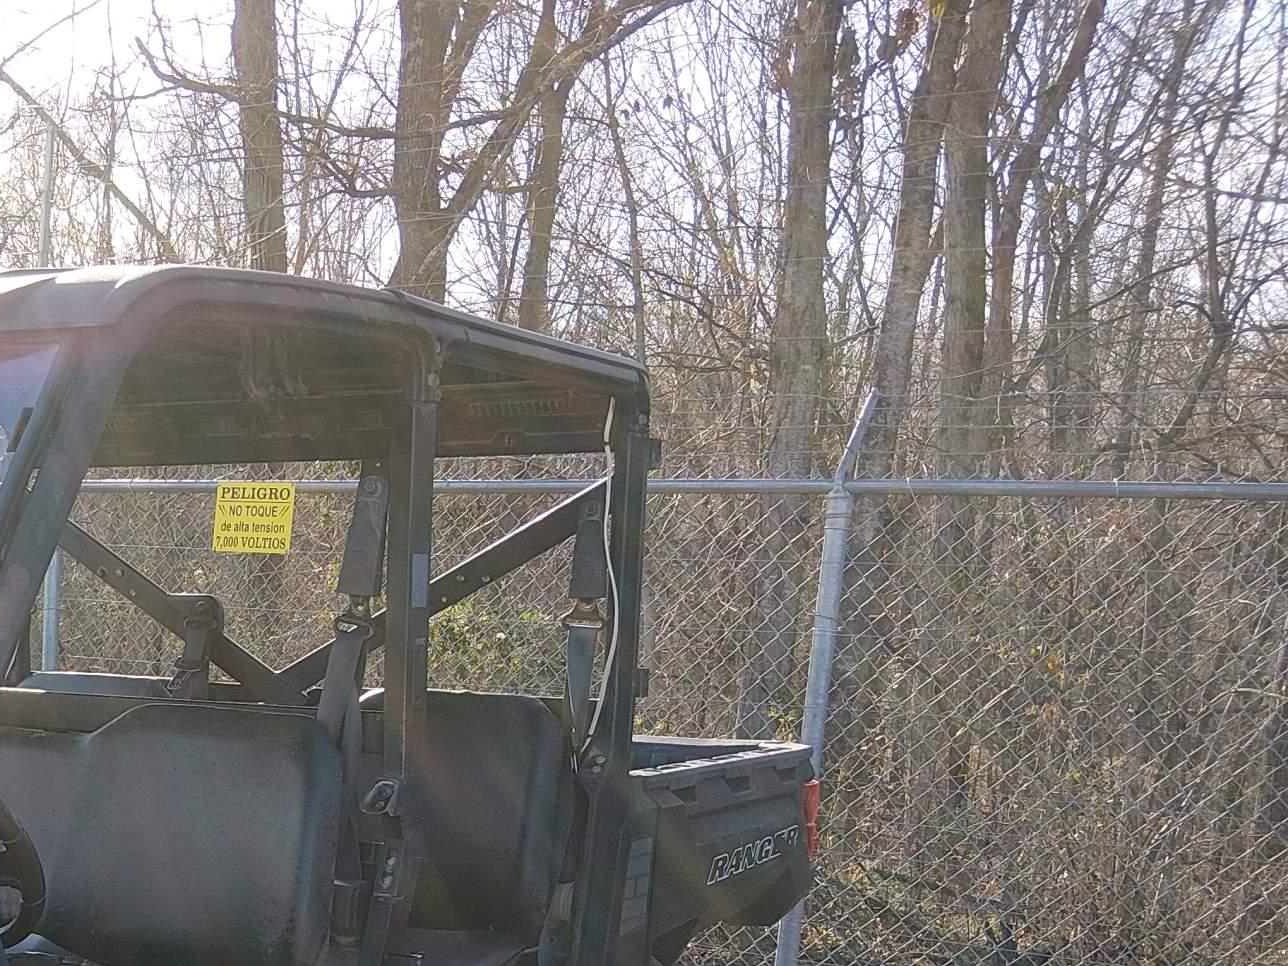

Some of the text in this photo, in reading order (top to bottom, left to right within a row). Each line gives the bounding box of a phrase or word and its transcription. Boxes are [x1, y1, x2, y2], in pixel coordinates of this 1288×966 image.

[221, 486, 291, 500] PELIGRO
[228, 504, 278, 518] NO TOQUE
[220, 520, 285, 534] de alta tension
[215, 535, 286, 550] 7,000 VOLTIOS
